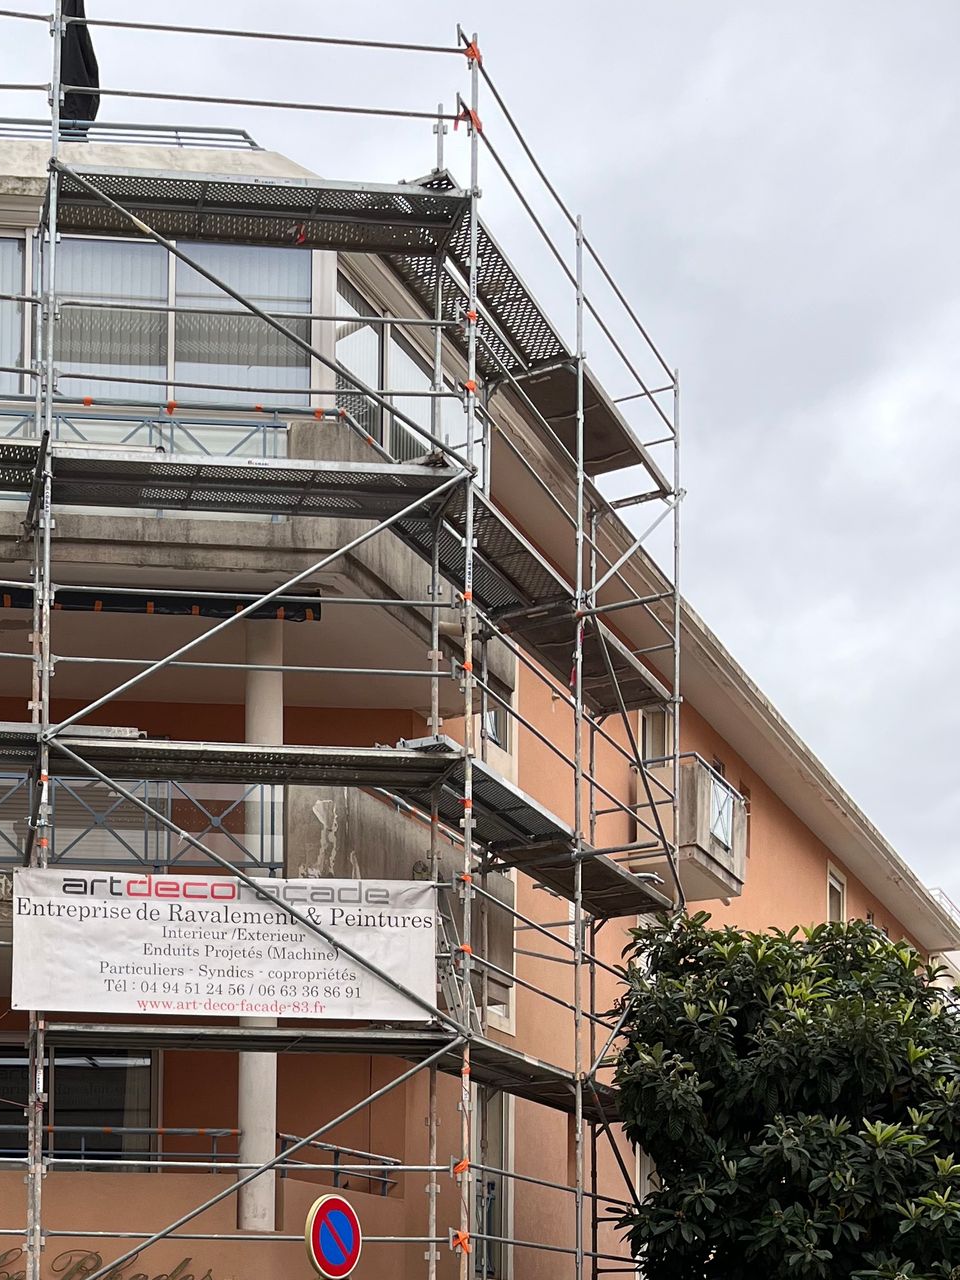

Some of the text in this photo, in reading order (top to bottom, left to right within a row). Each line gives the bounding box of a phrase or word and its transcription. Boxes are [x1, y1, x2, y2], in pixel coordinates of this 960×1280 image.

[16, 897, 433, 929] Entreprise de Ravalement & Peintures
[162, 926, 228, 940] Interieur
[143, 943, 339, 962] Enduits Projetés (Machine)
[99, 961, 185, 976] Particuliers
[198, 964, 255, 980] Syndics
[268, 967, 357, 982] copropriétés
[104, 979, 127, 992] Tél
[140, 981, 157, 993] 04
[162, 982, 179, 994] 94
[184, 983, 200, 994] 51
[206, 983, 222, 995] 24
[228, 983, 245, 996] 56
[249, 984, 254, 996] /
[258, 985, 275, 997] 06
[280, 985, 297, 998] 63
[302, 986, 319, 998] 36
[324, 986, 341, 999] 86
[345, 987, 361, 999] 91
[137, 999, 326, 1014] www.art-deco-facade-83.fr
